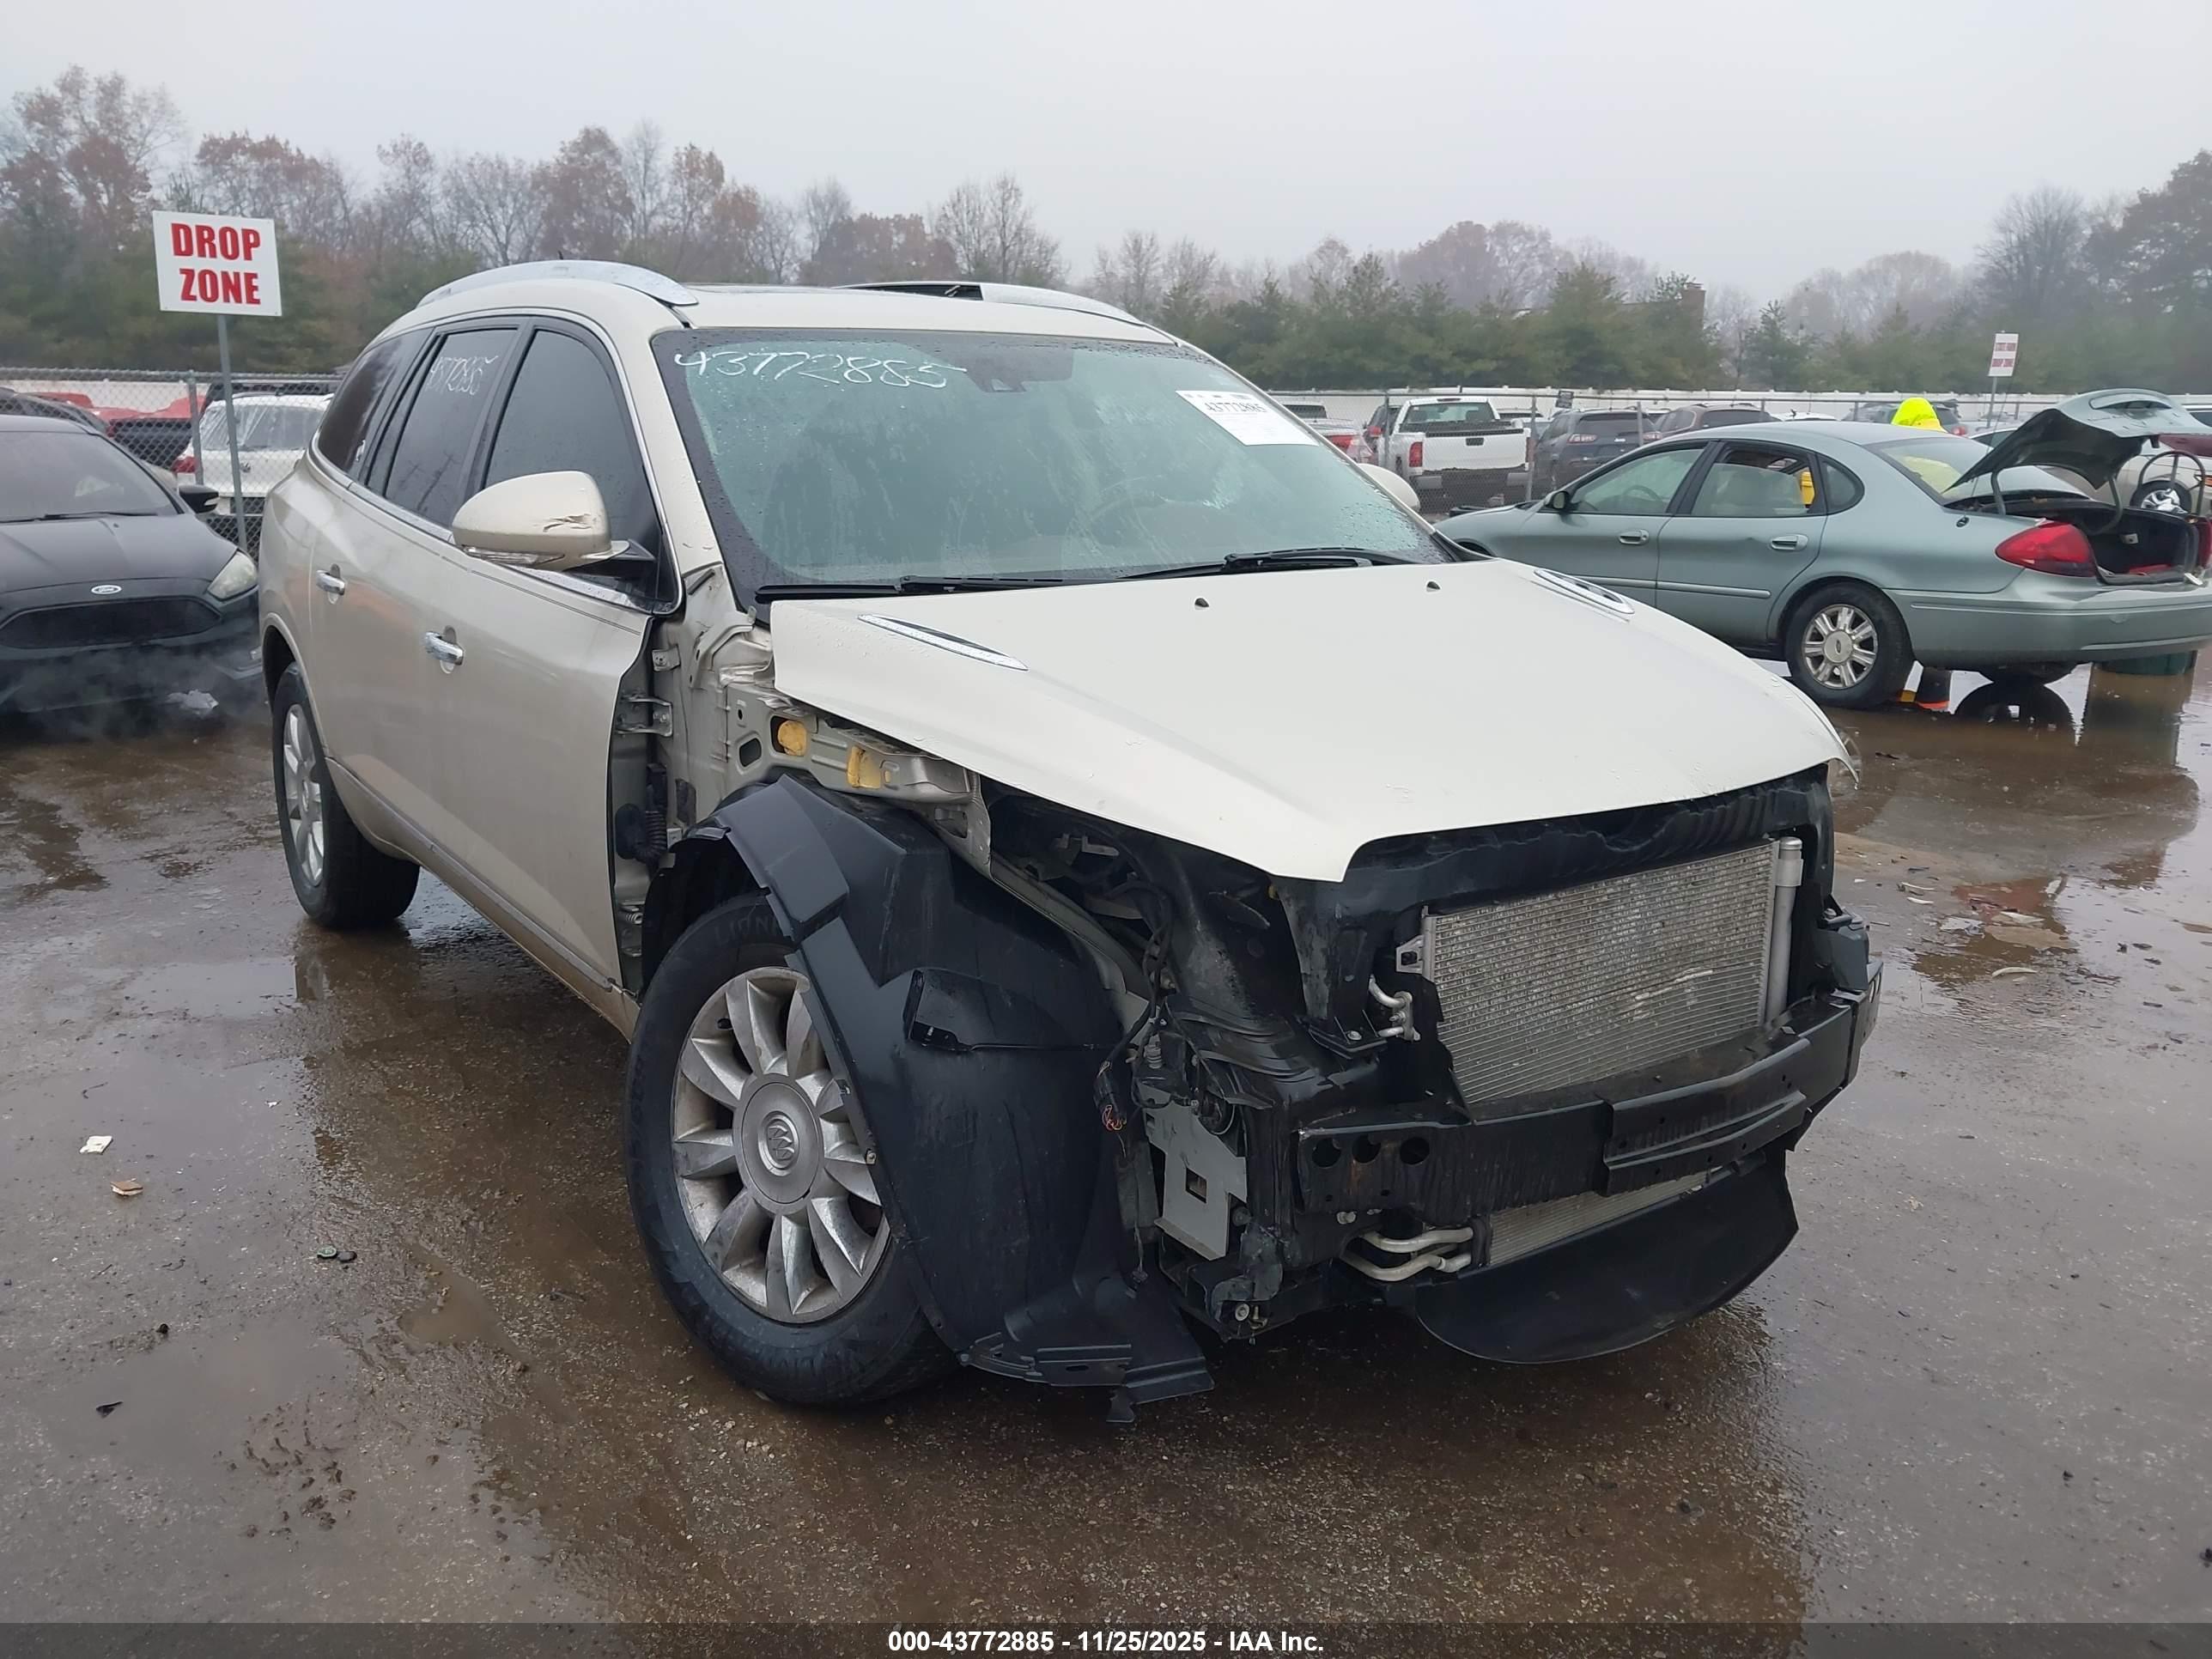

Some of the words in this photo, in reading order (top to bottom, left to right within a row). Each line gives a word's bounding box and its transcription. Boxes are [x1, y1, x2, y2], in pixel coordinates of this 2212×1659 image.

[171, 222, 261, 261] DROP
[179, 268, 261, 305] ZONE
[674, 351, 968, 388] 43772885
